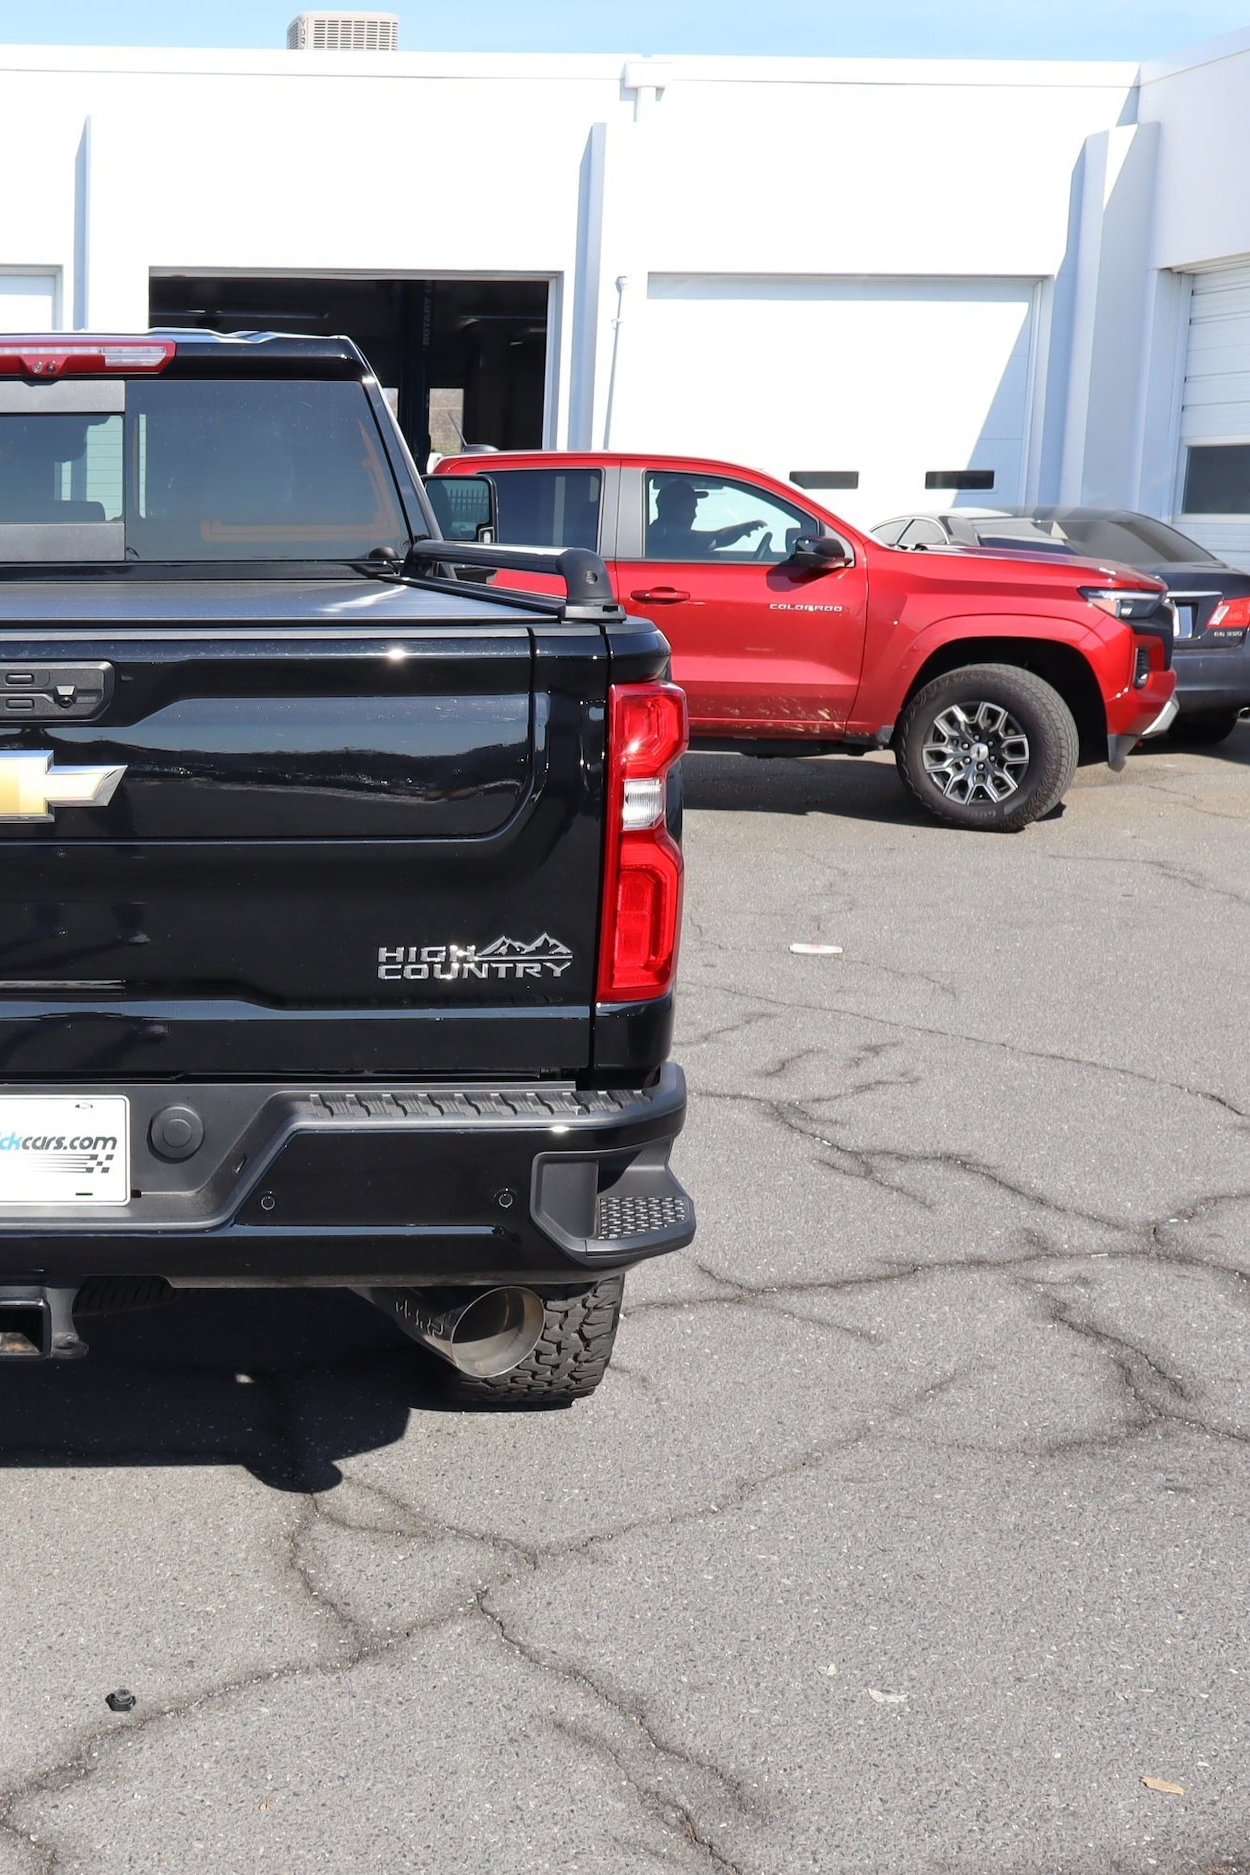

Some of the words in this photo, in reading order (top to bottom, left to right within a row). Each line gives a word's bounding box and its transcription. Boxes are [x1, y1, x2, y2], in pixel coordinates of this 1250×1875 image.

[769, 603, 843, 612] COLORADO
[377, 945, 477, 963] HIGH
[377, 962, 571, 980] COUNTRY
